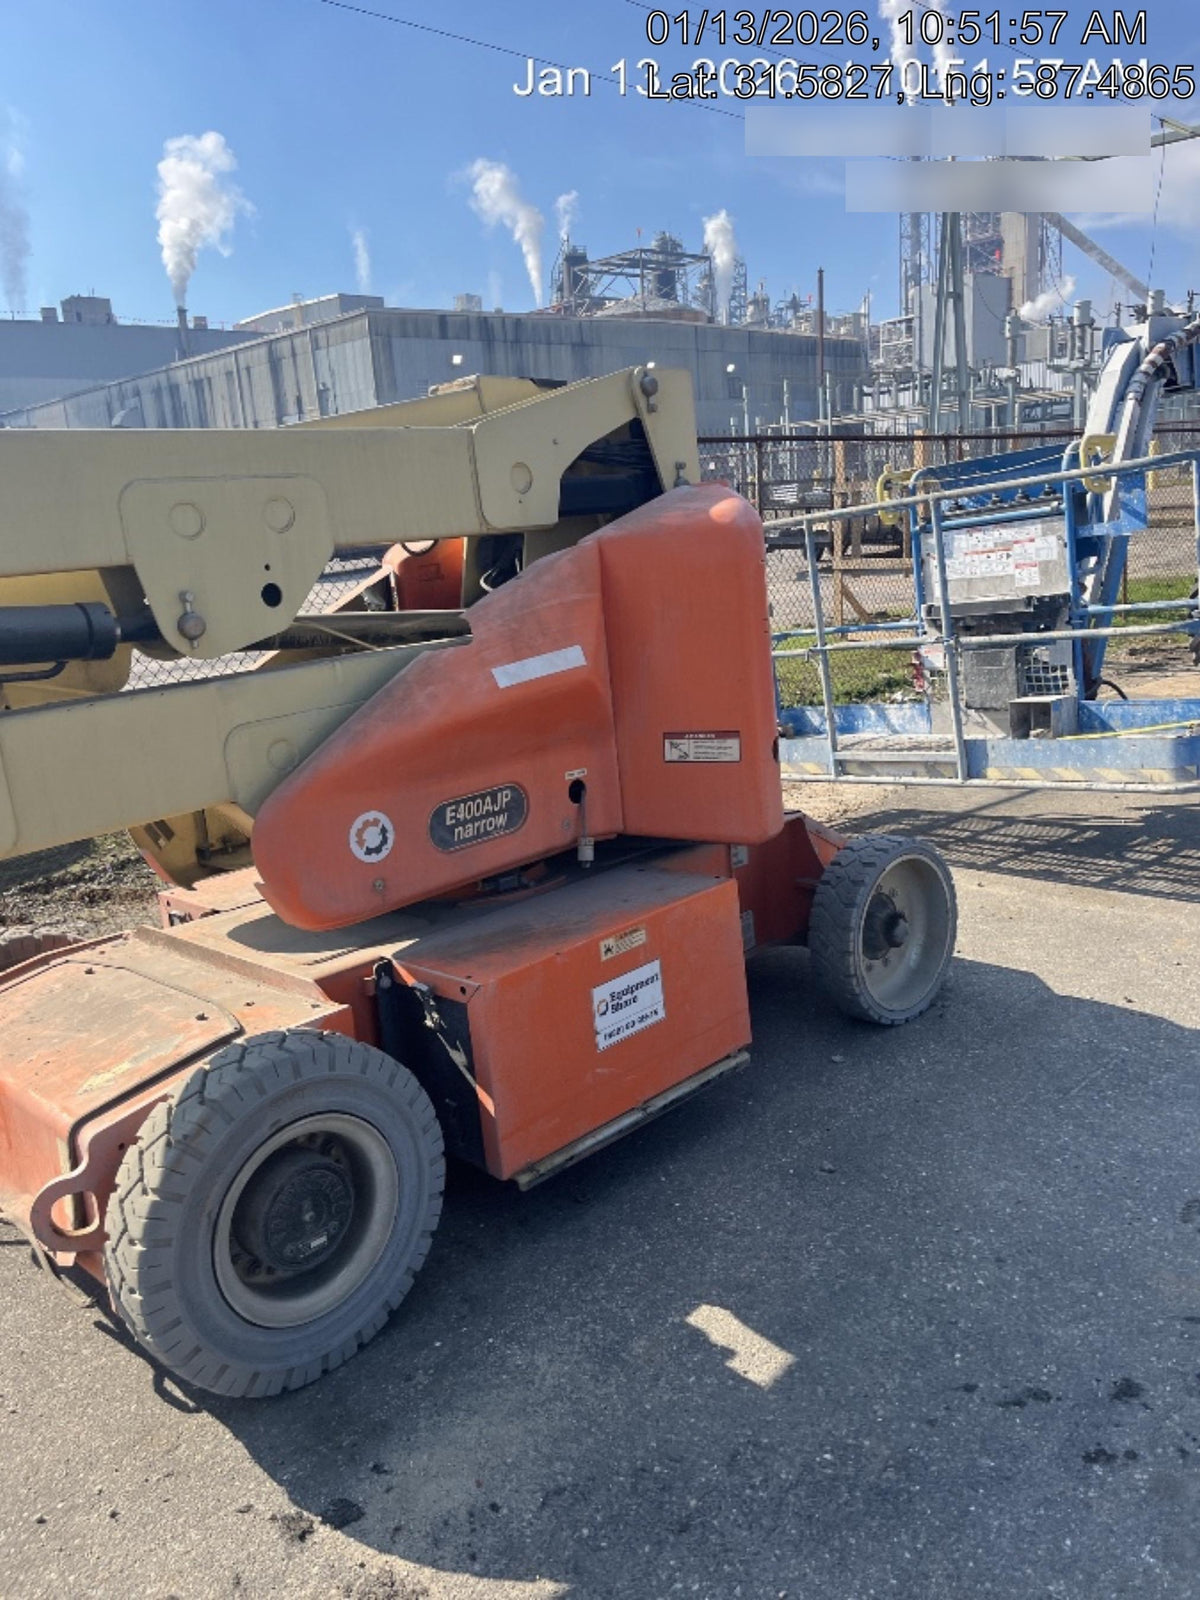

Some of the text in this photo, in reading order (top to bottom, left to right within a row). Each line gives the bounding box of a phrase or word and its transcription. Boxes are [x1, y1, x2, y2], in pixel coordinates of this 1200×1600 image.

[445, 789, 511, 826] E400AJP
[454, 812, 508, 842] narrow
[609, 973, 659, 1002] Equipment
[611, 995, 638, 1014] Share
